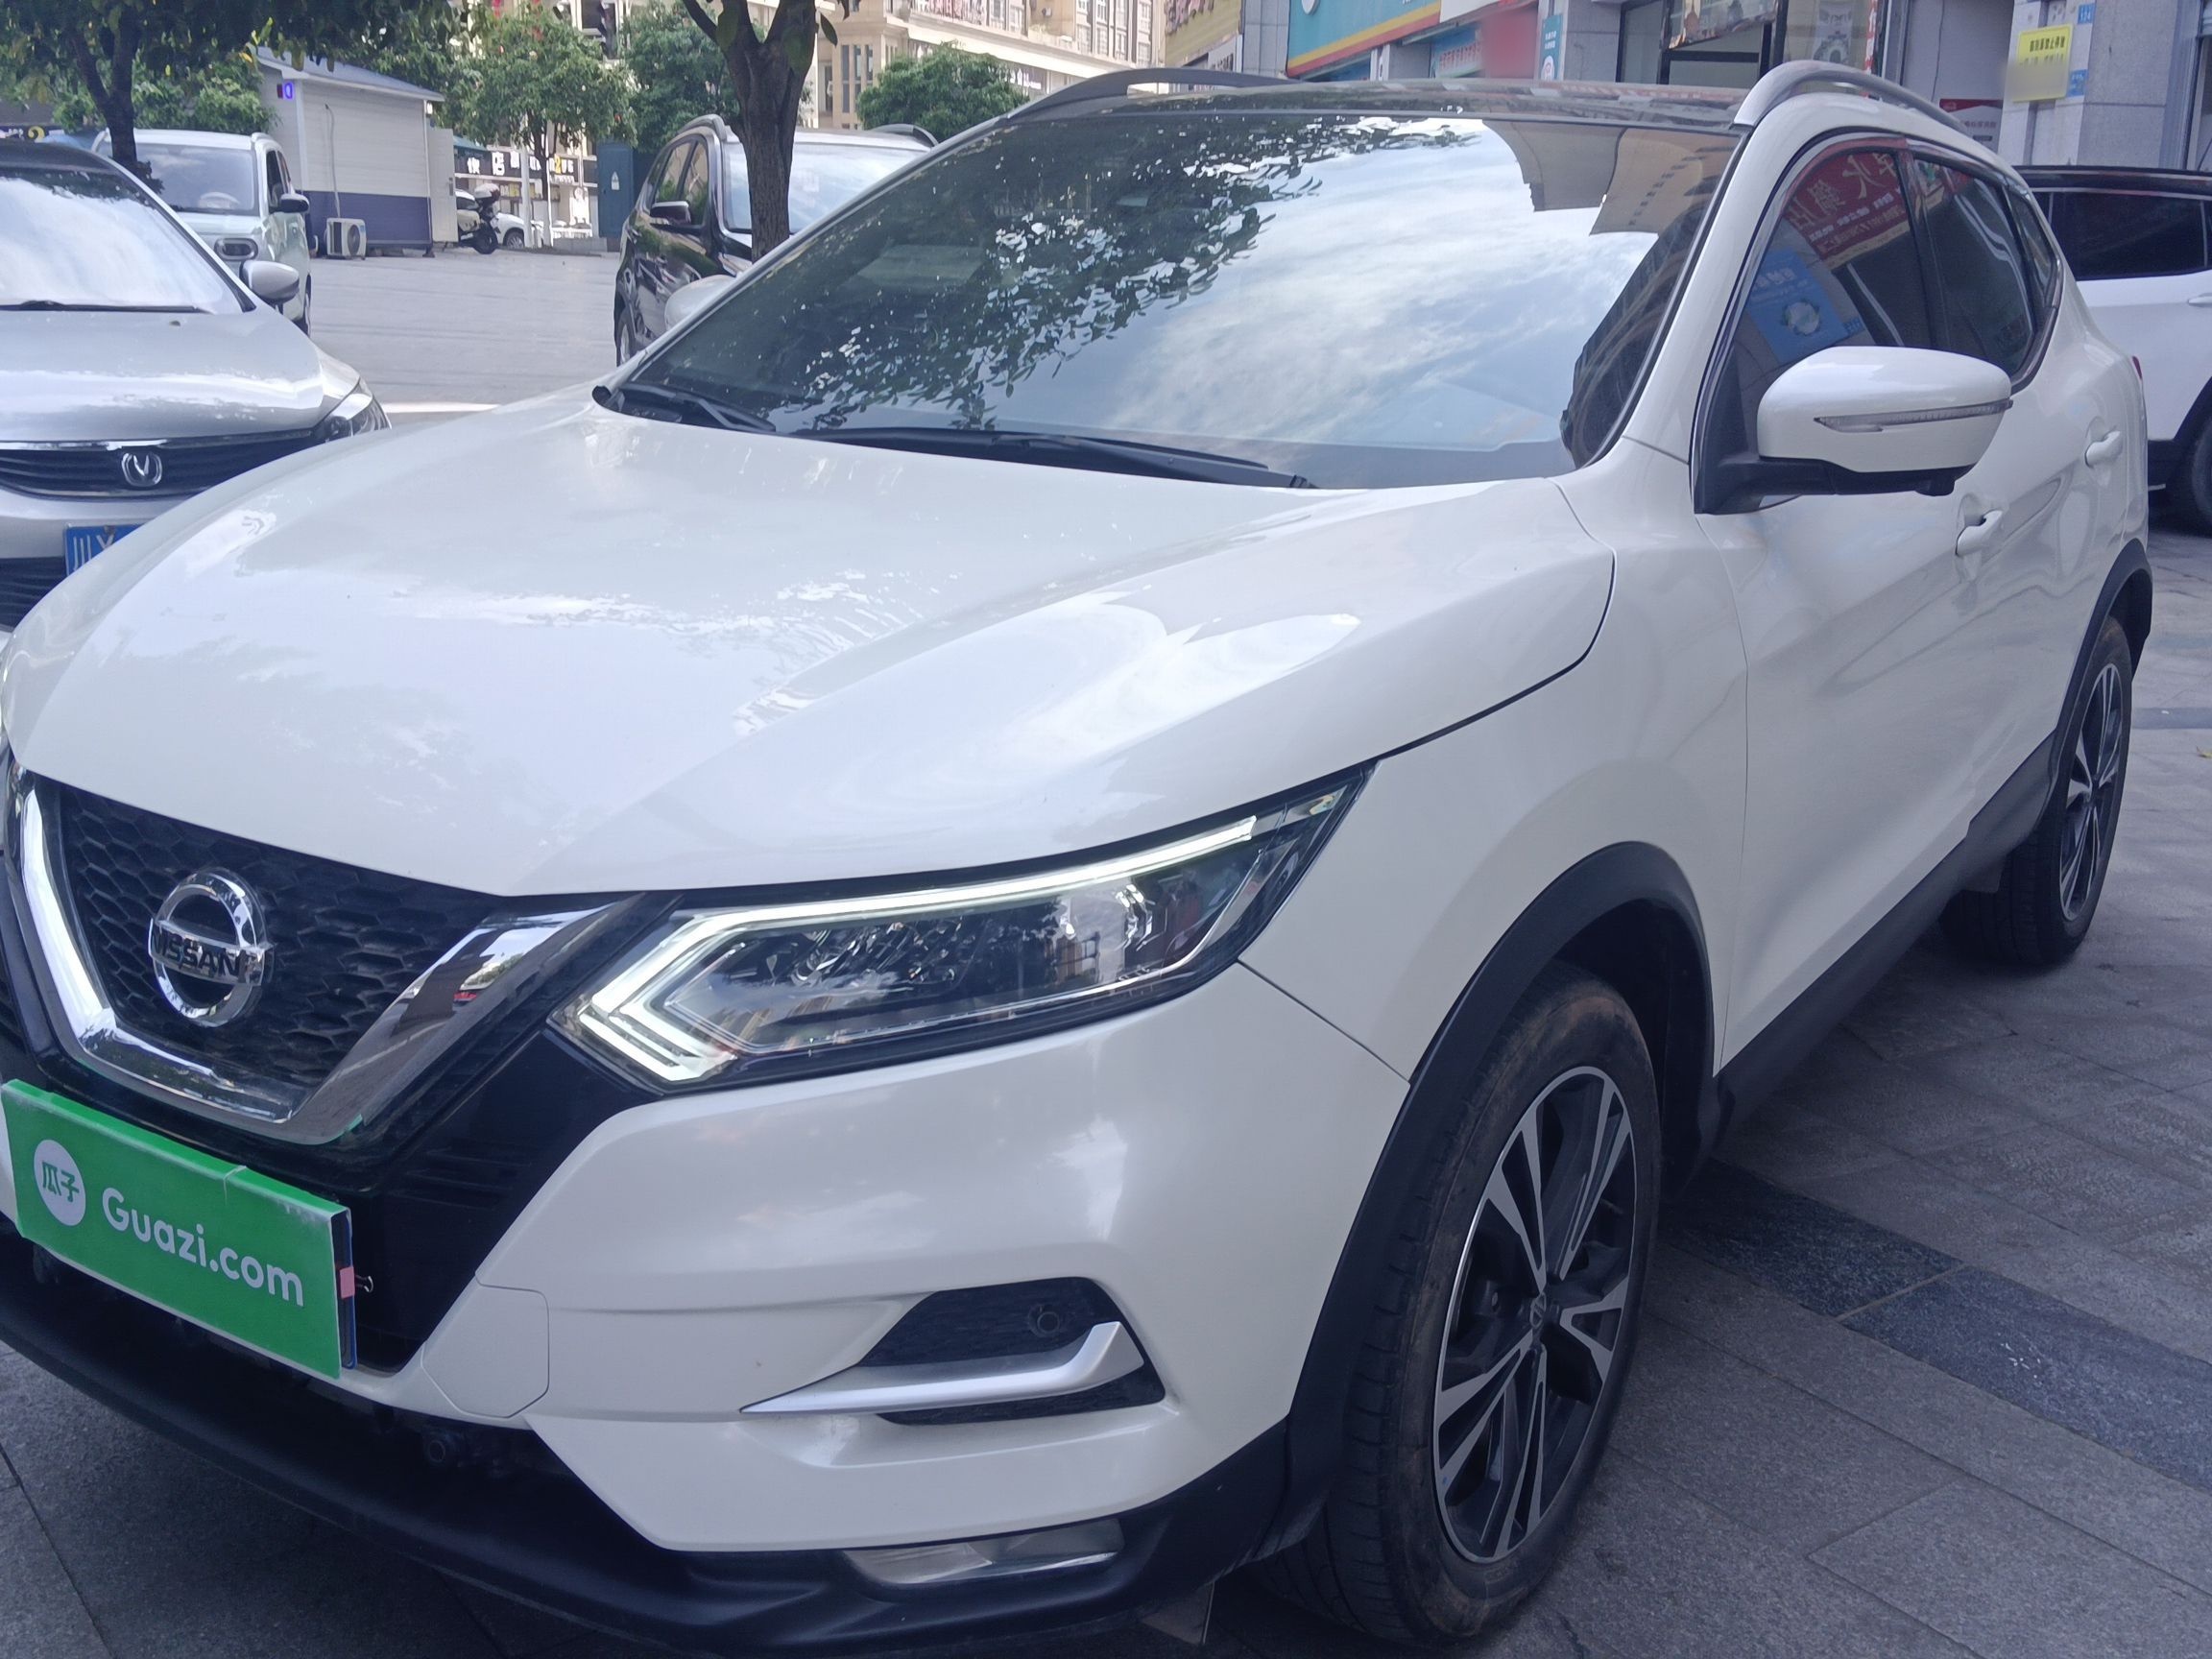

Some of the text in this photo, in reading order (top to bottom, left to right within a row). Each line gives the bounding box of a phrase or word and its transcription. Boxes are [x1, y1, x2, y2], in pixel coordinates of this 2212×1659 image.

[152, 926, 249, 983] NISSAN
[41, 1161, 80, 1203] 瓜子
[102, 1187, 304, 1307] Guazi.com
